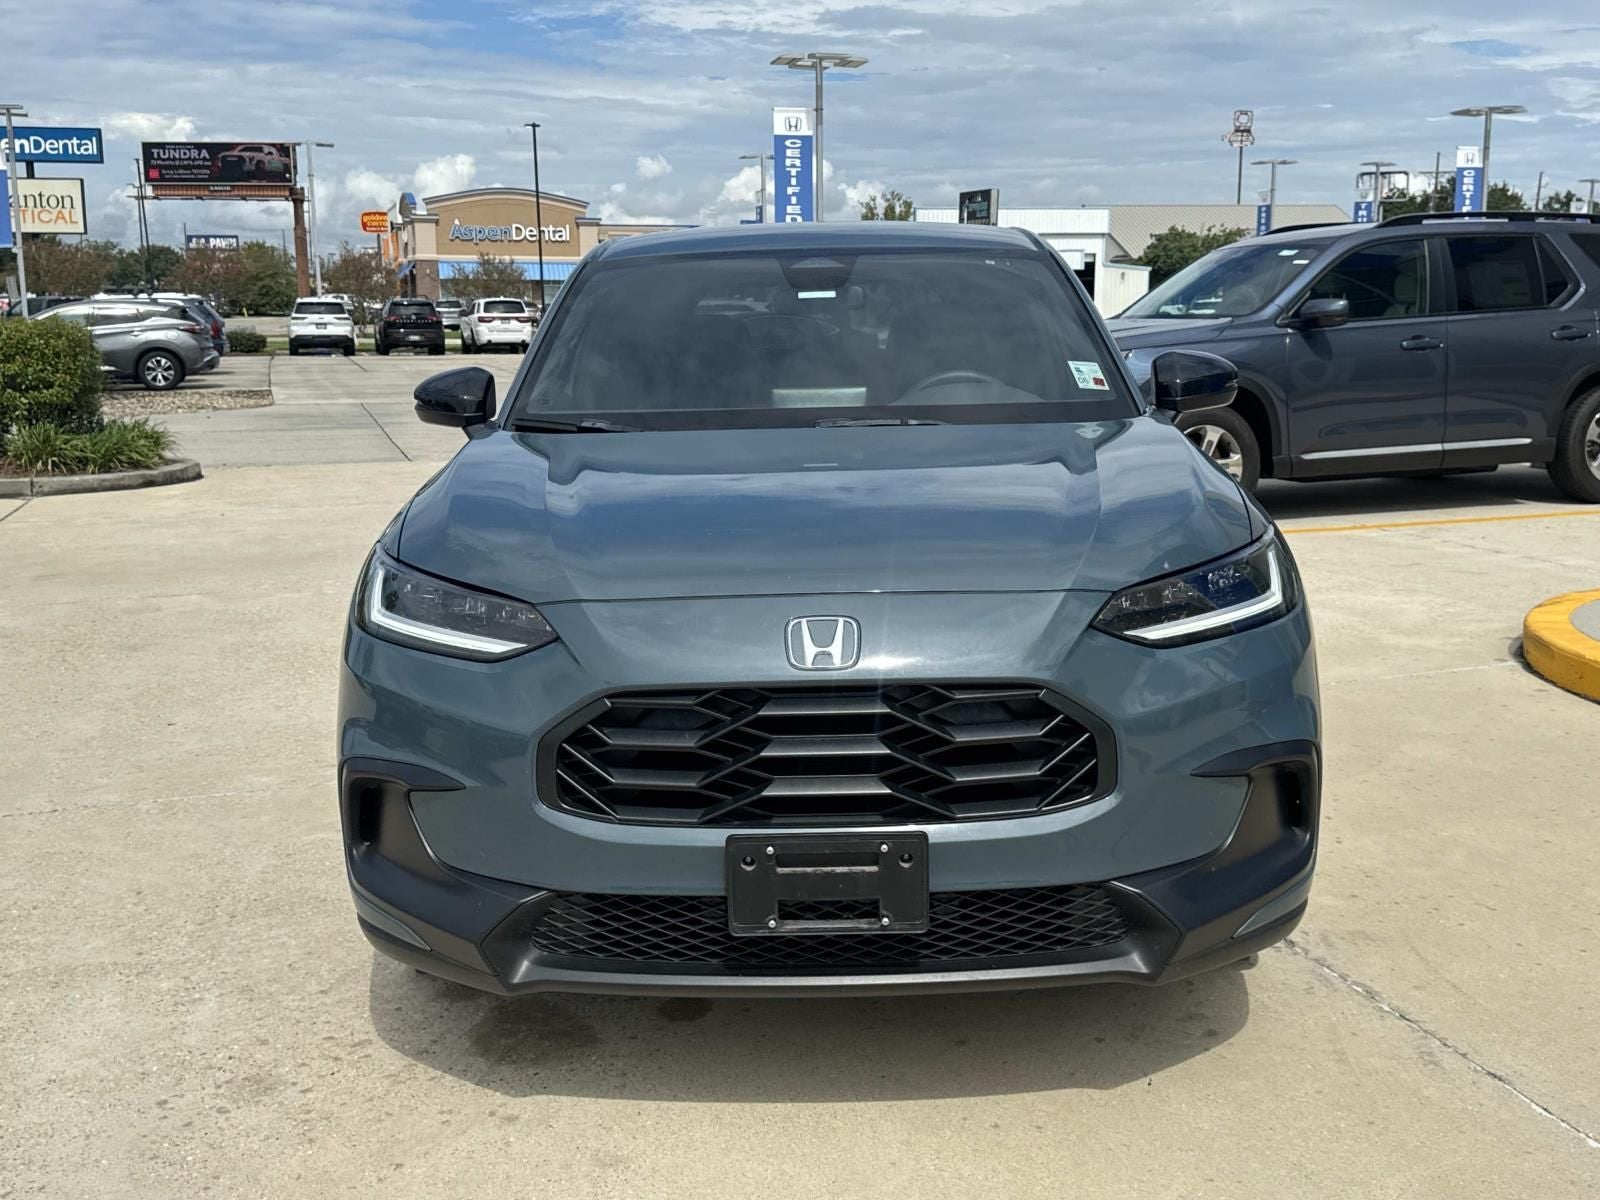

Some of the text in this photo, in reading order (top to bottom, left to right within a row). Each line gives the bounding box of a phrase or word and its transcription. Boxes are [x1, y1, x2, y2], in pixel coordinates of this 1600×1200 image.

[151, 149, 210, 159] TUNDRA
[784, 139, 803, 223] CERTIFIED
[450, 219, 570, 244] AspenDental
